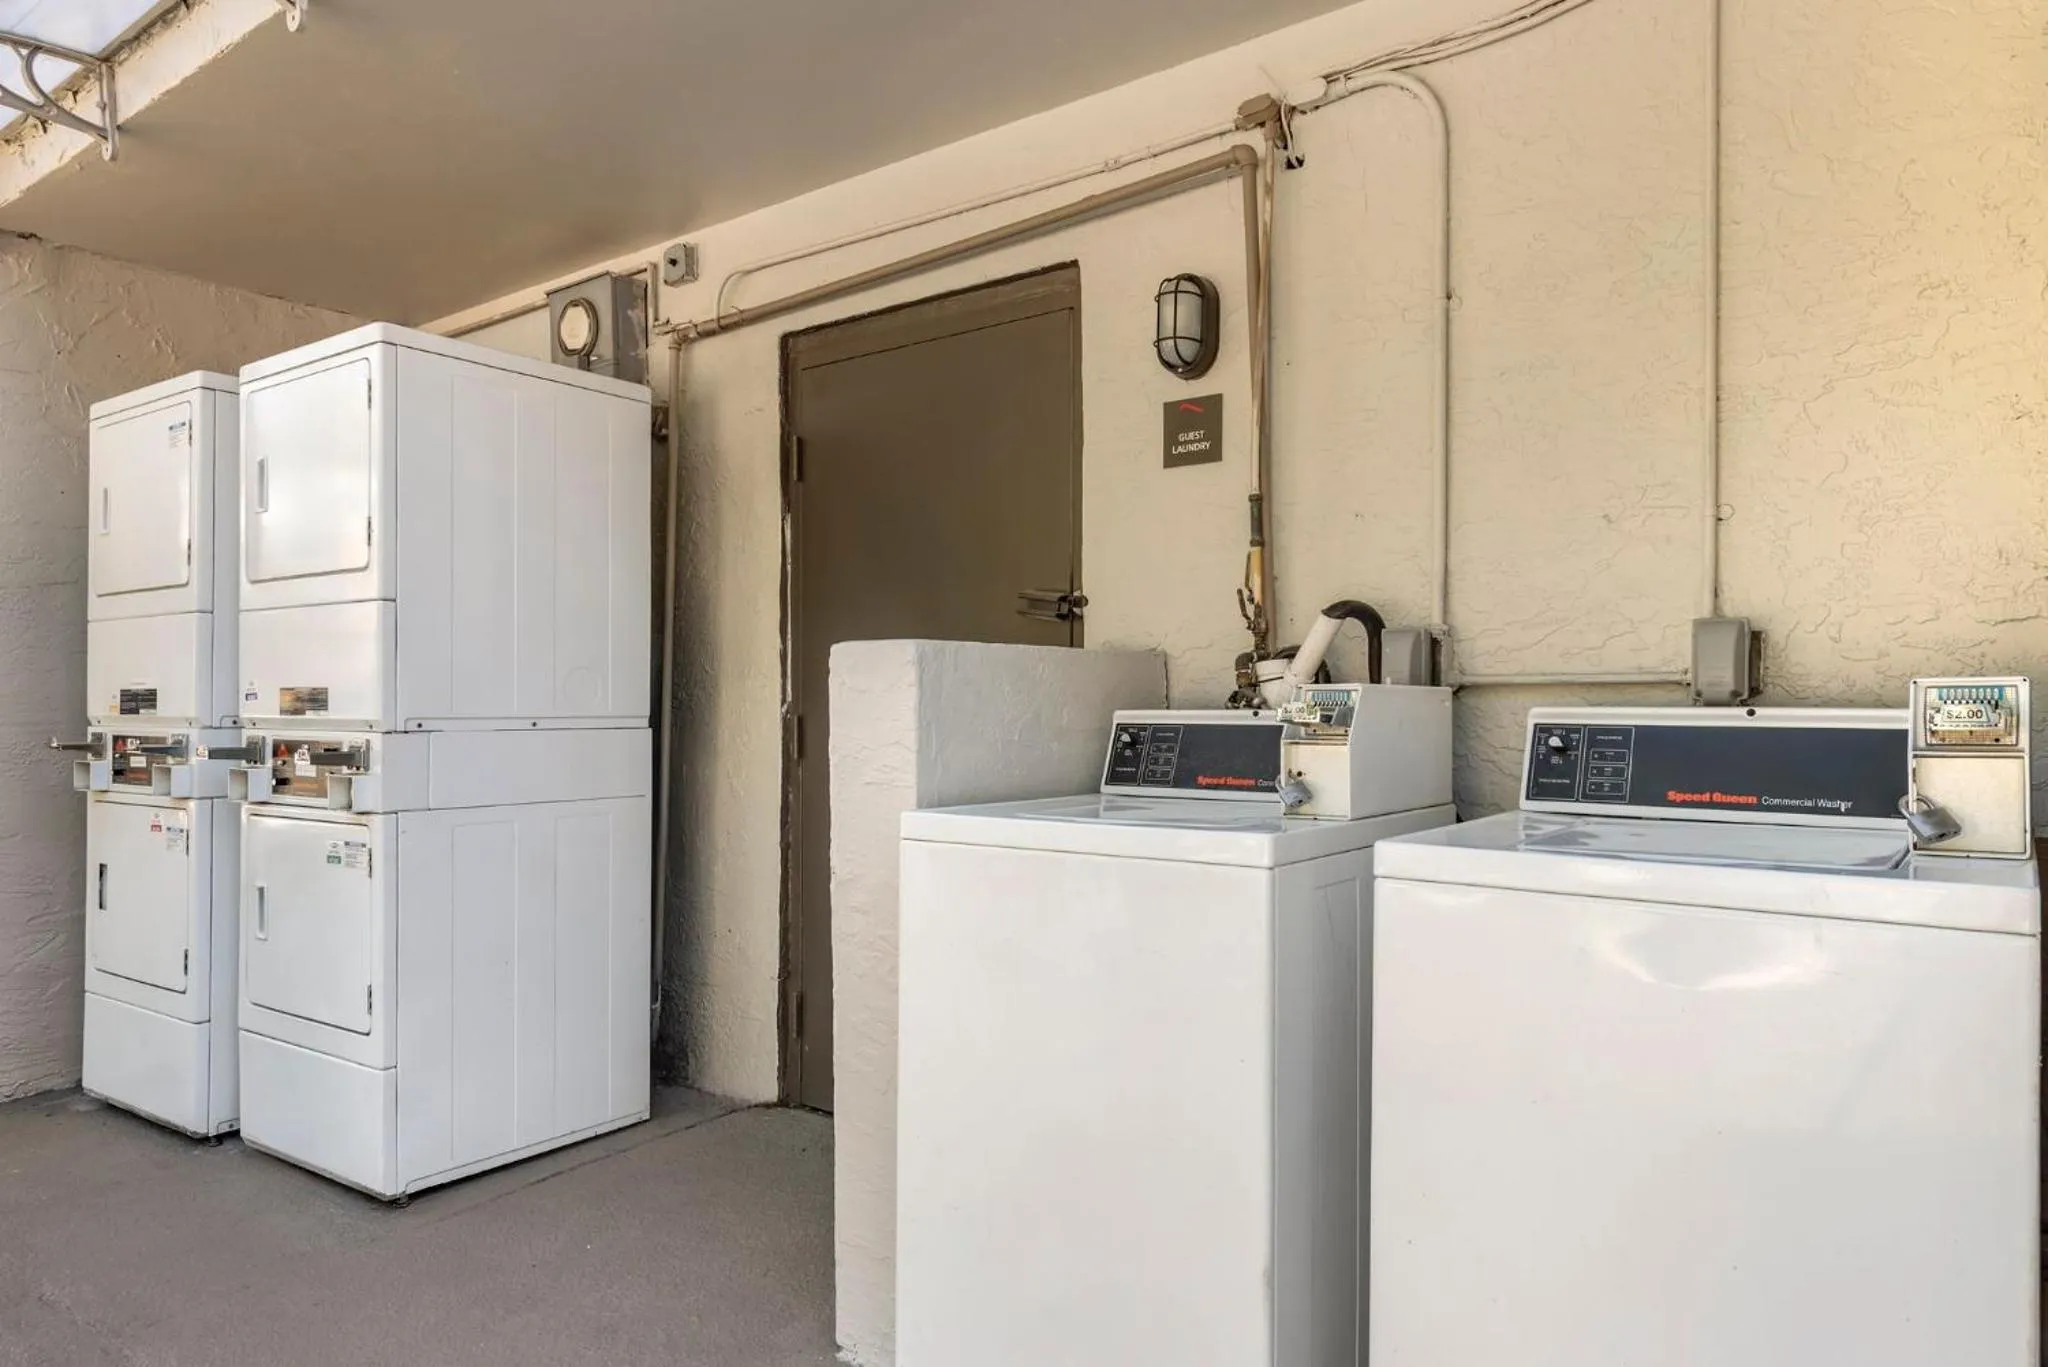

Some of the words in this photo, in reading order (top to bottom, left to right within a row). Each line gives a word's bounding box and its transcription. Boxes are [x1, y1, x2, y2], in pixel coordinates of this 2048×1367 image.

[1178, 430, 1205, 441] GUEST
[1172, 440, 1211, 454] LAUNDRY
[1946, 708, 1984, 719] $2.00
[1667, 790, 1710, 803] Speed
[1711, 791, 1758, 804] Queen
[1761, 795, 1815, 808] Commercial
